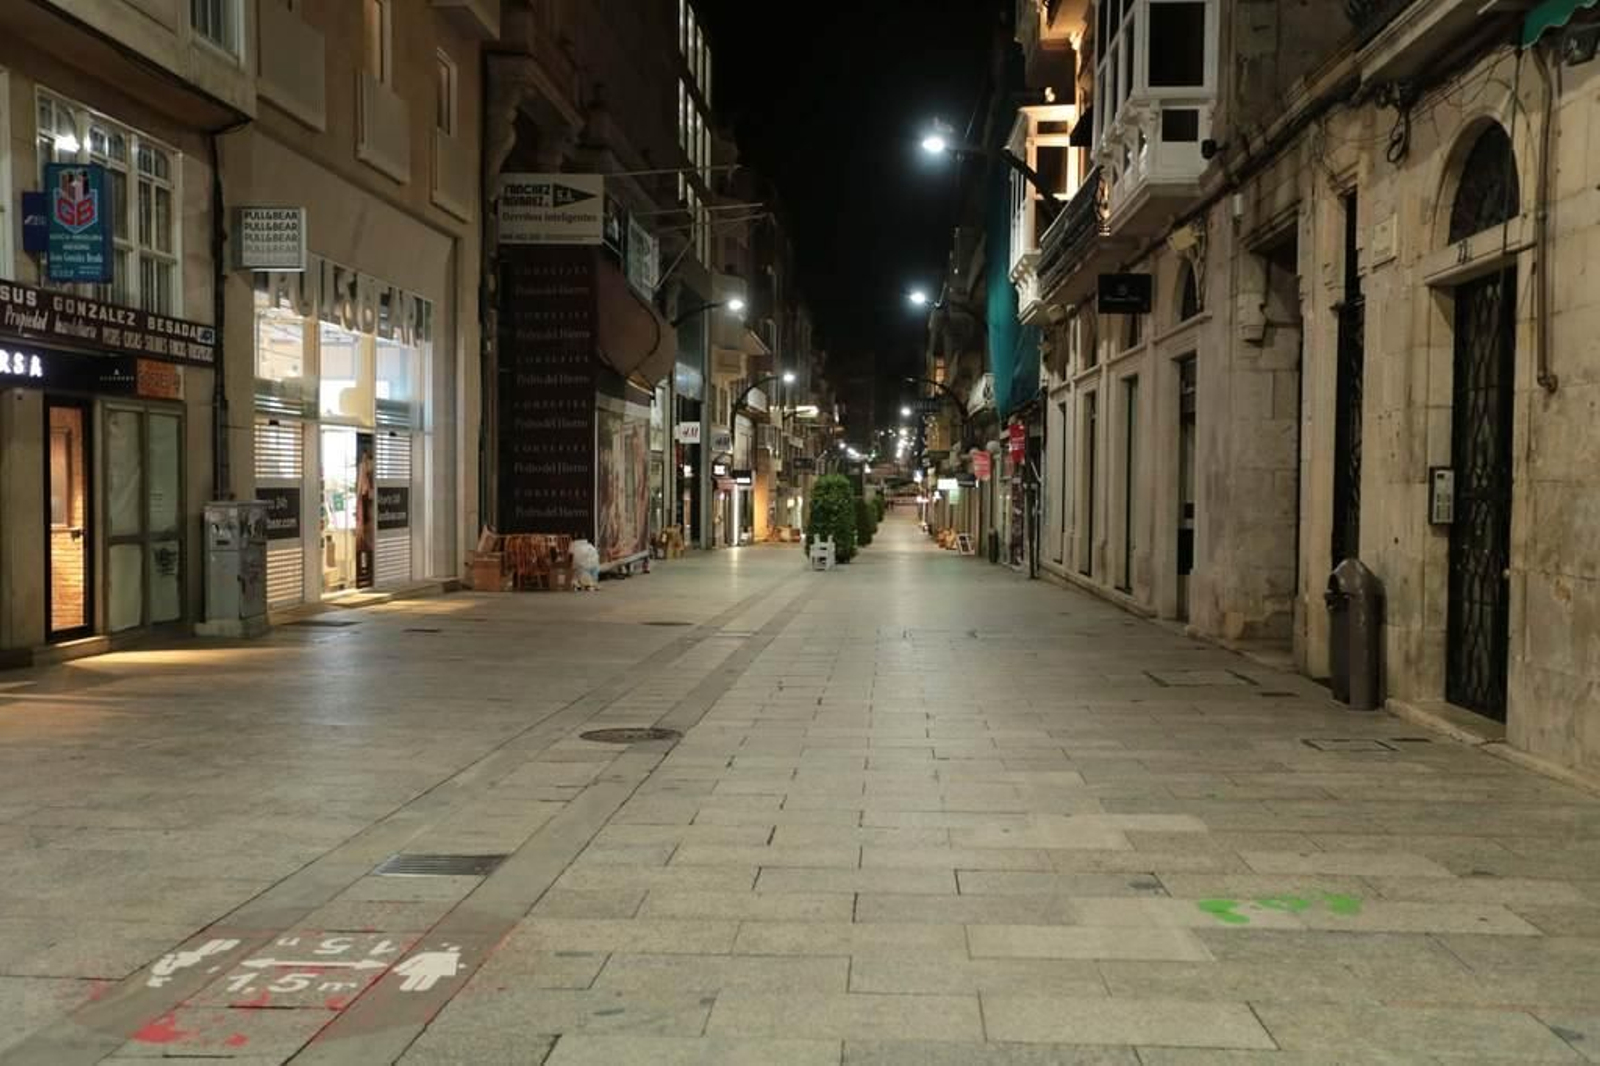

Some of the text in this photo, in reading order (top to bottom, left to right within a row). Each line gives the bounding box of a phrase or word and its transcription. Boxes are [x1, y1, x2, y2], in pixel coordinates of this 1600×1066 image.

[244, 211, 298, 220] PULL&BEAR
[545, 211, 598, 224] inteligentes
[244, 222, 298, 231] PULL&BEAR
[244, 233, 298, 242] PULL&BEAR
[4, 304, 48, 335] Propiedad
[53, 296, 136, 327] GONZALEZ
[147, 316, 196, 338] BESADA
